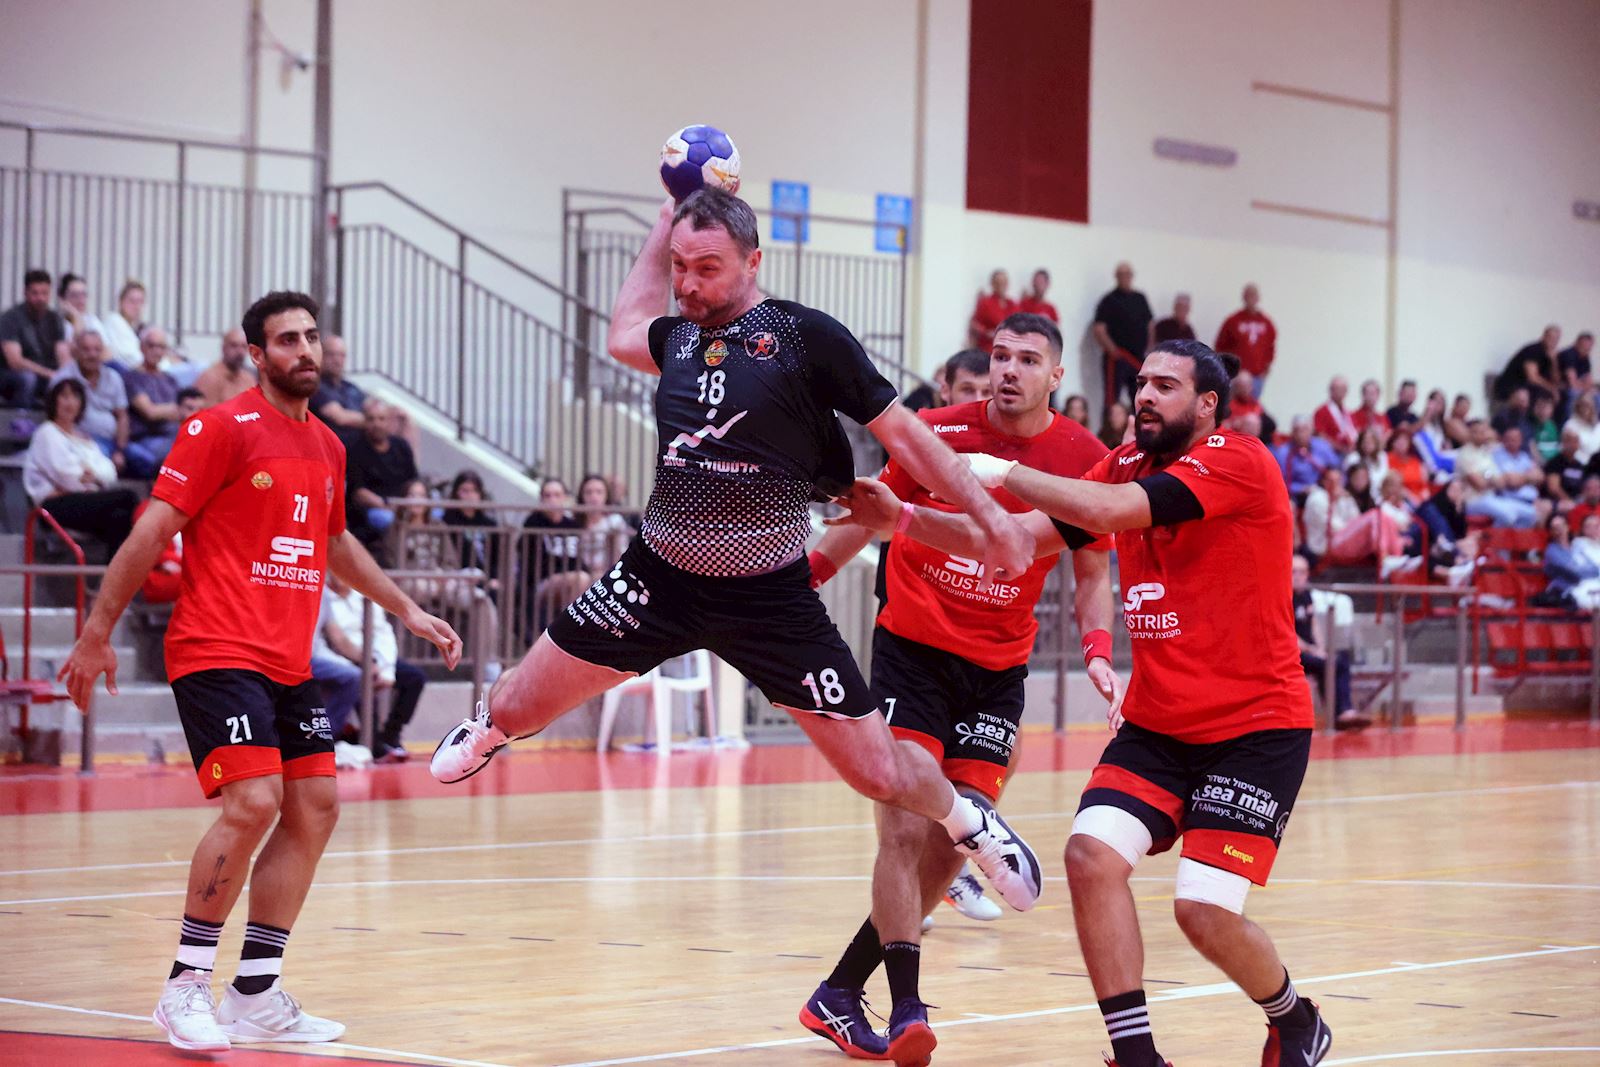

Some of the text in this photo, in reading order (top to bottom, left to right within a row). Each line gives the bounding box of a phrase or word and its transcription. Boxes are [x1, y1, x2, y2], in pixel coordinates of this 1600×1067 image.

[697, 369, 726, 405] 18
[234, 411, 261, 423] Kempa
[934, 423, 968, 434] Kempa
[1118, 452, 1144, 465] Kemp
[293, 493, 309, 523] 21
[251, 561, 321, 583] INDUSTRIES
[801, 668, 846, 708] 18
[226, 713, 253, 744] 21
[973, 722, 1006, 741] sea
[1201, 784, 1279, 819] sea mall
[1222, 844, 1254, 864] Kempa
